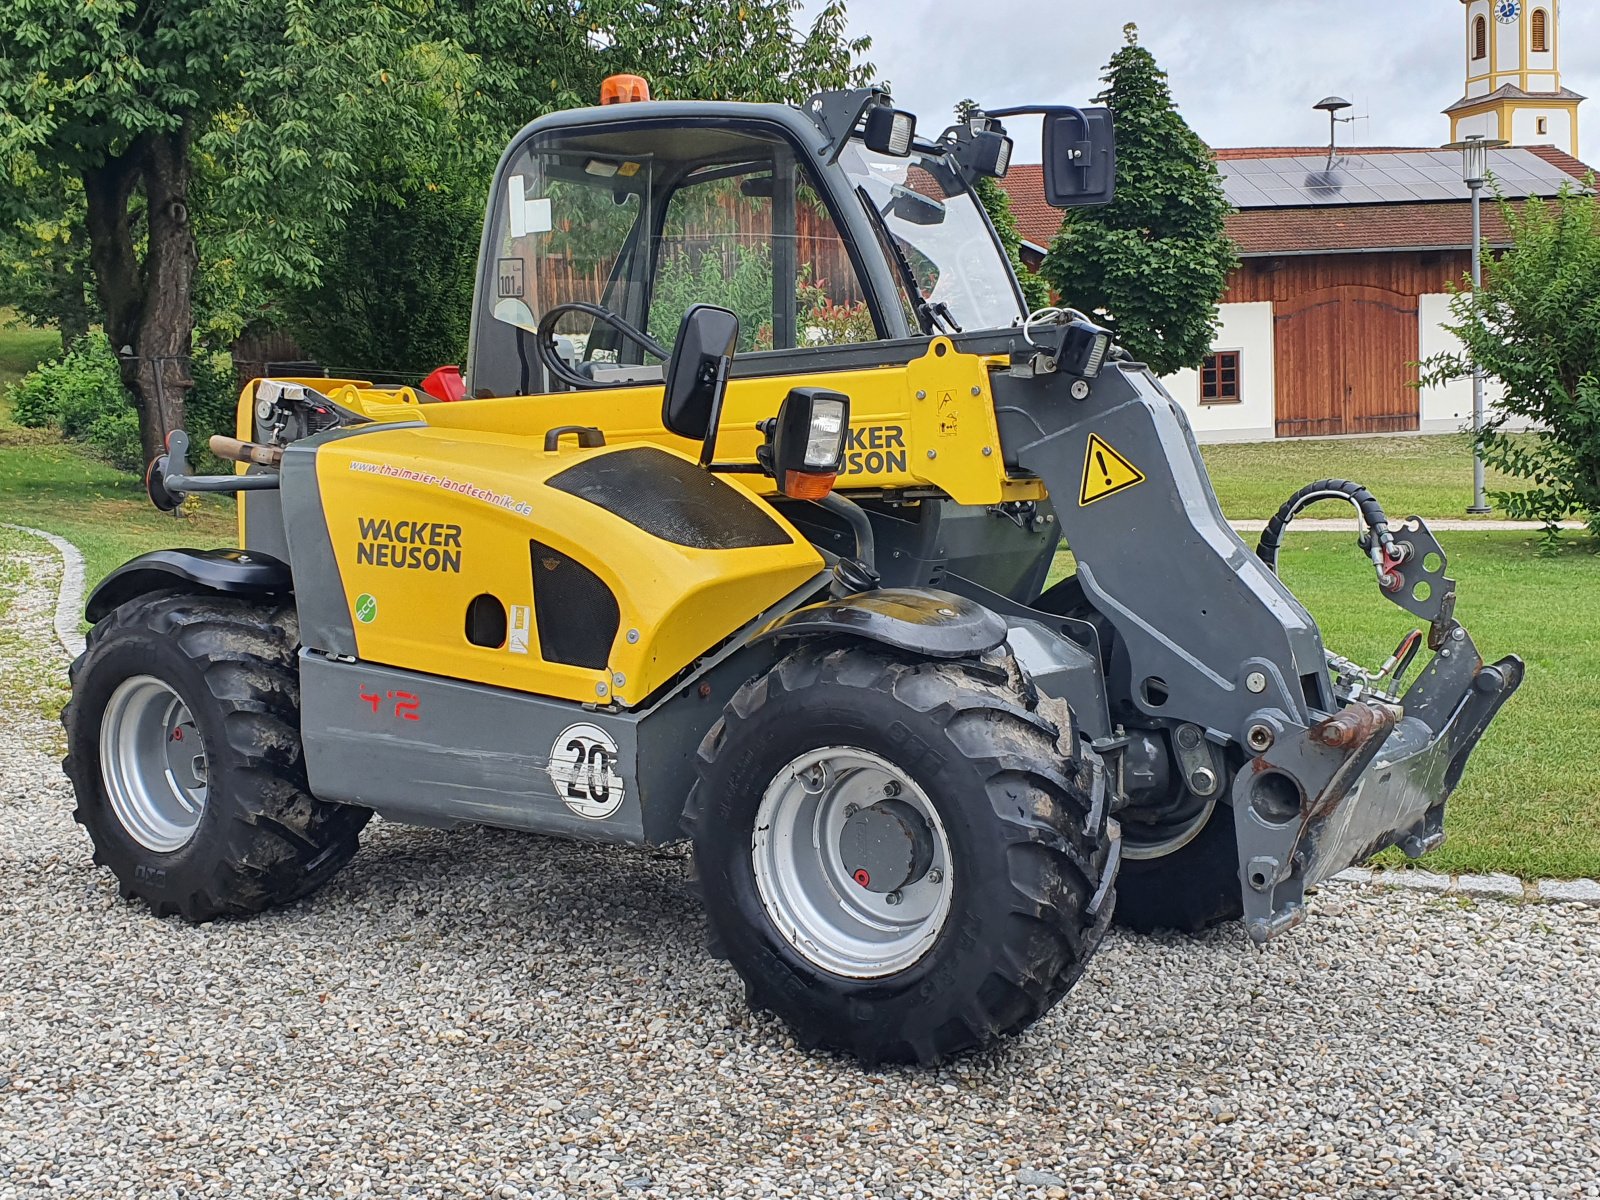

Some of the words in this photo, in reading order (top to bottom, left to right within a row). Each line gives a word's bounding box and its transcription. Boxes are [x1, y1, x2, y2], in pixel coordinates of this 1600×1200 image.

[500, 275, 515, 295] 101
[847, 425, 905, 451] KER
[349, 462, 531, 514] www.thalmaier-landtechnik.de
[357, 517, 462, 548] WACKER
[356, 542, 461, 573] NEUSON
[357, 596, 376, 620] ECO
[565, 739, 611, 803] 20
